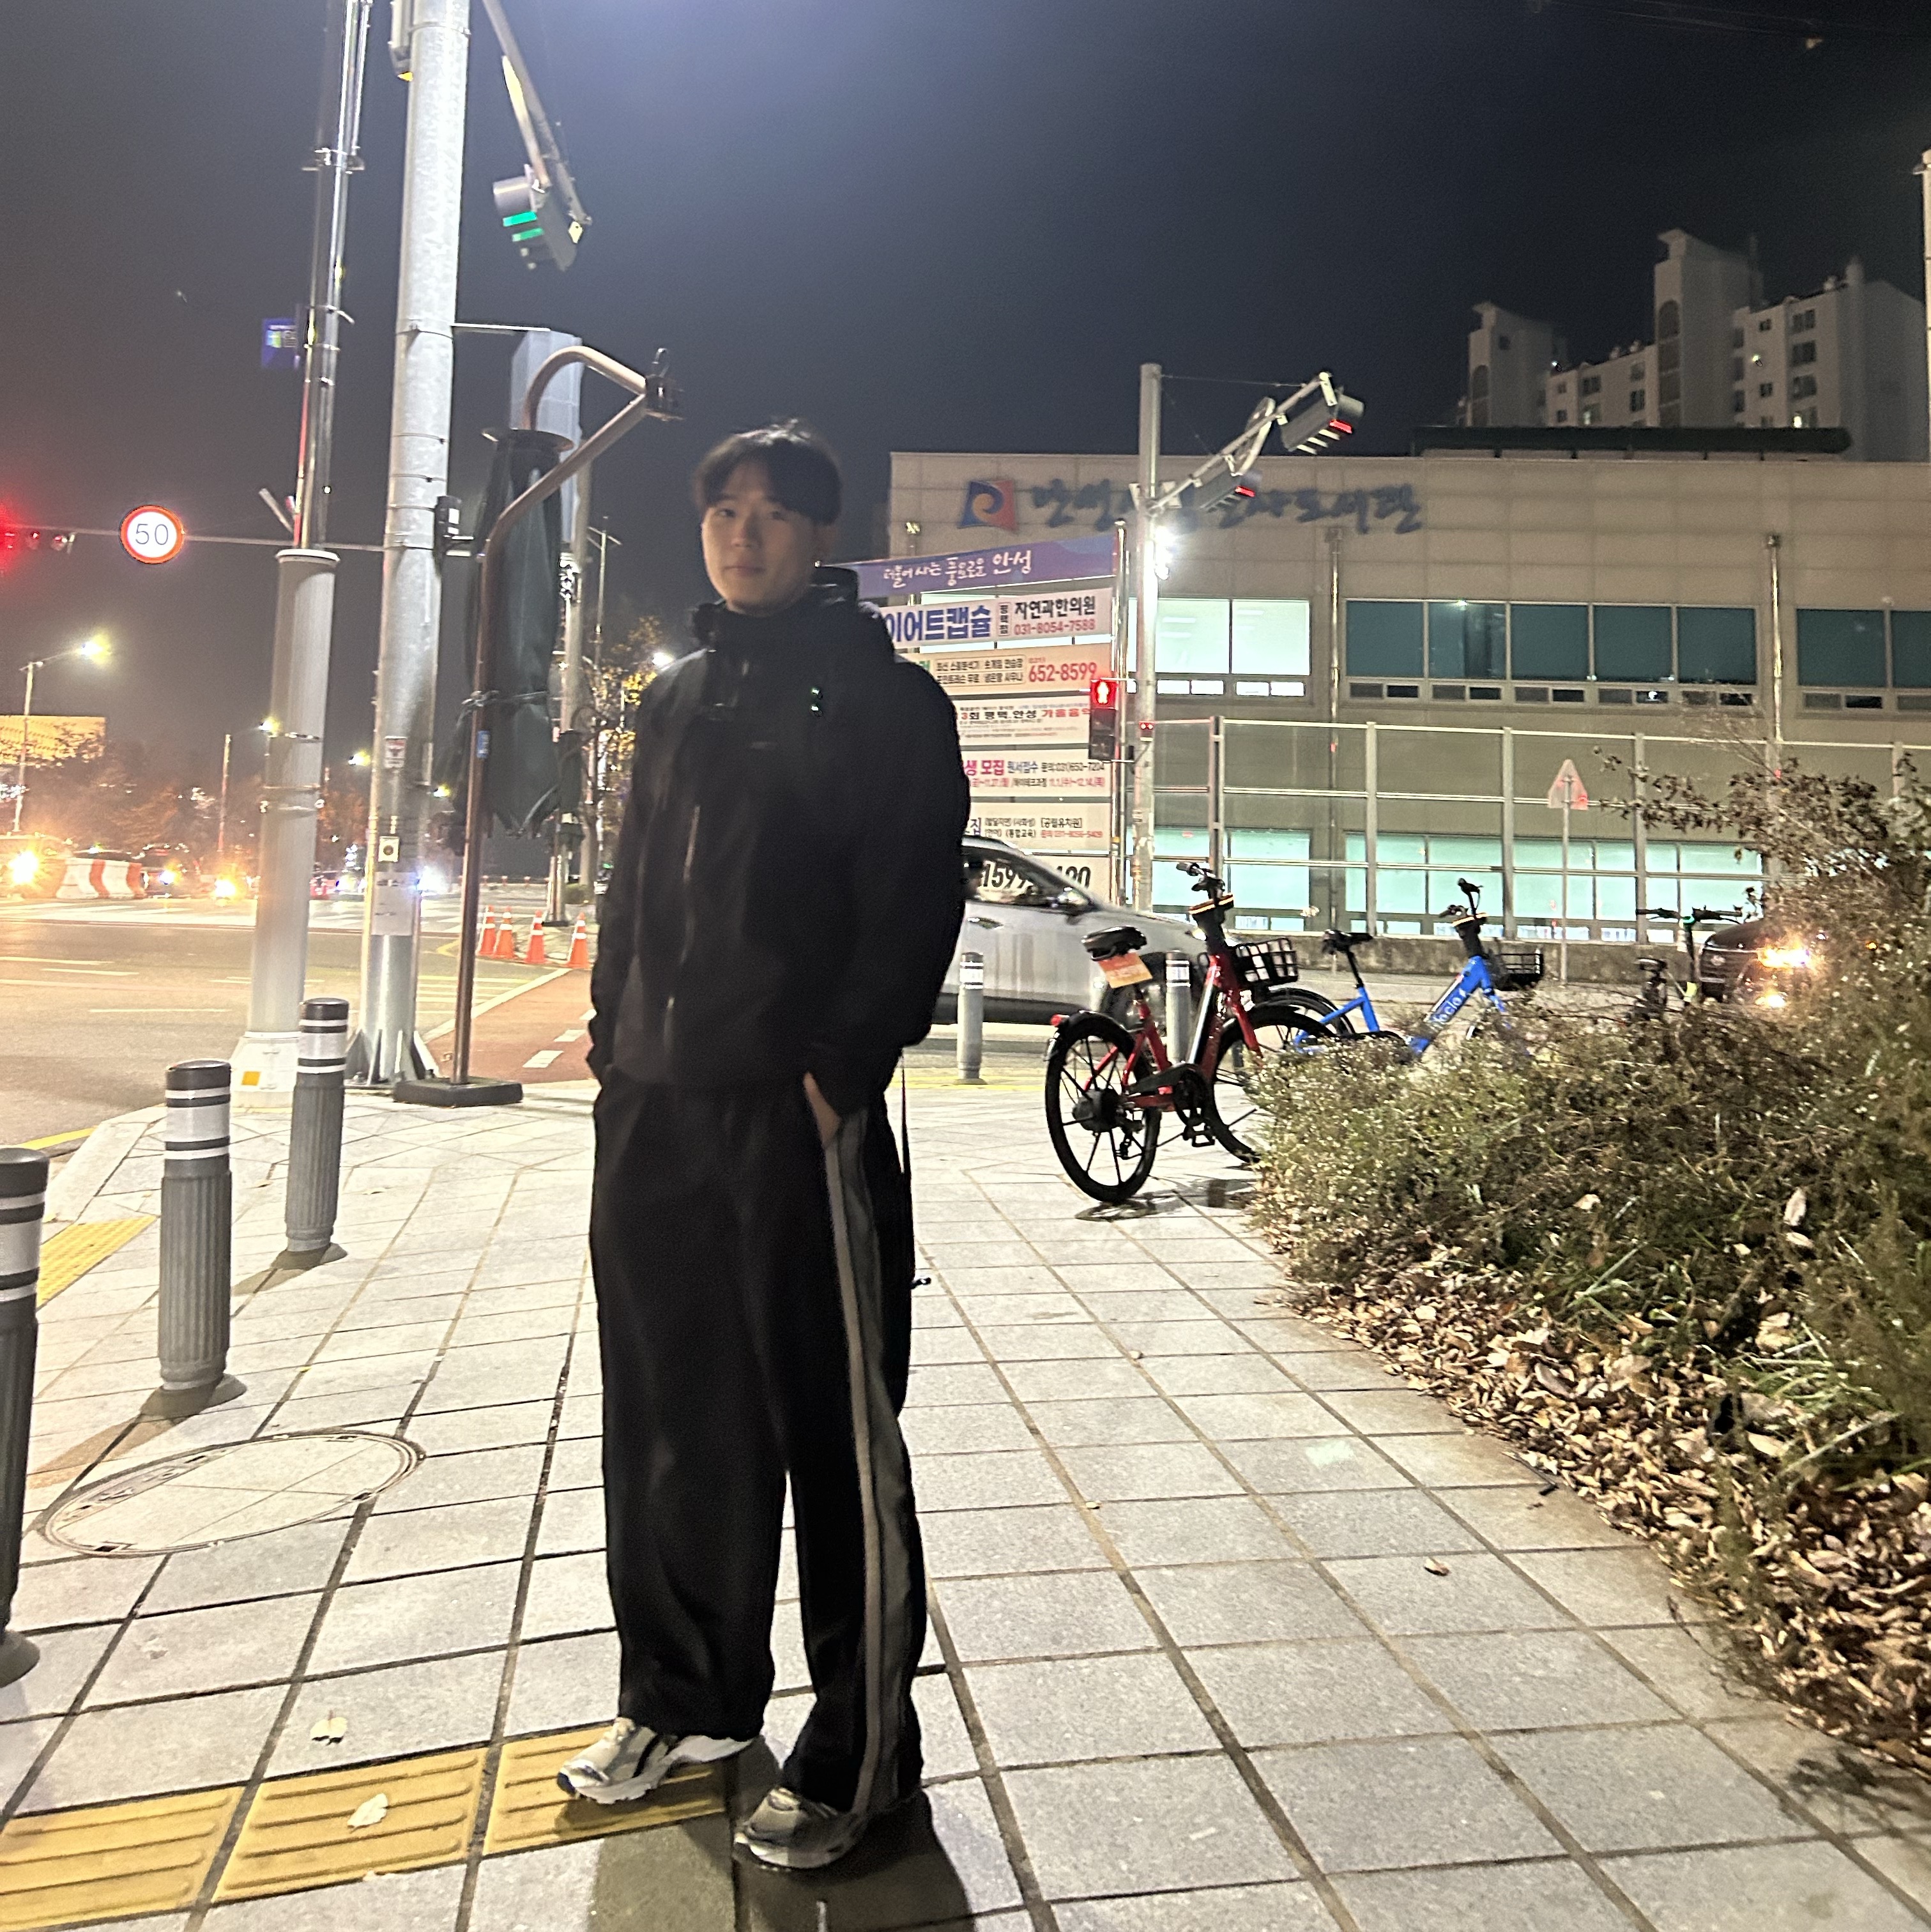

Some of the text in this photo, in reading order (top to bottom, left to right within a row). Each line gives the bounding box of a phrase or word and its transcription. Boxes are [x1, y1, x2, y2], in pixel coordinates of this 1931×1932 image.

[135, 523, 169, 546] 50
[992, 549, 1032, 575] 안성
[1014, 596, 1096, 620] 자연과한의원
[1028, 661, 1097, 682] 652-8599
[981, 760, 1005, 776] 모집
